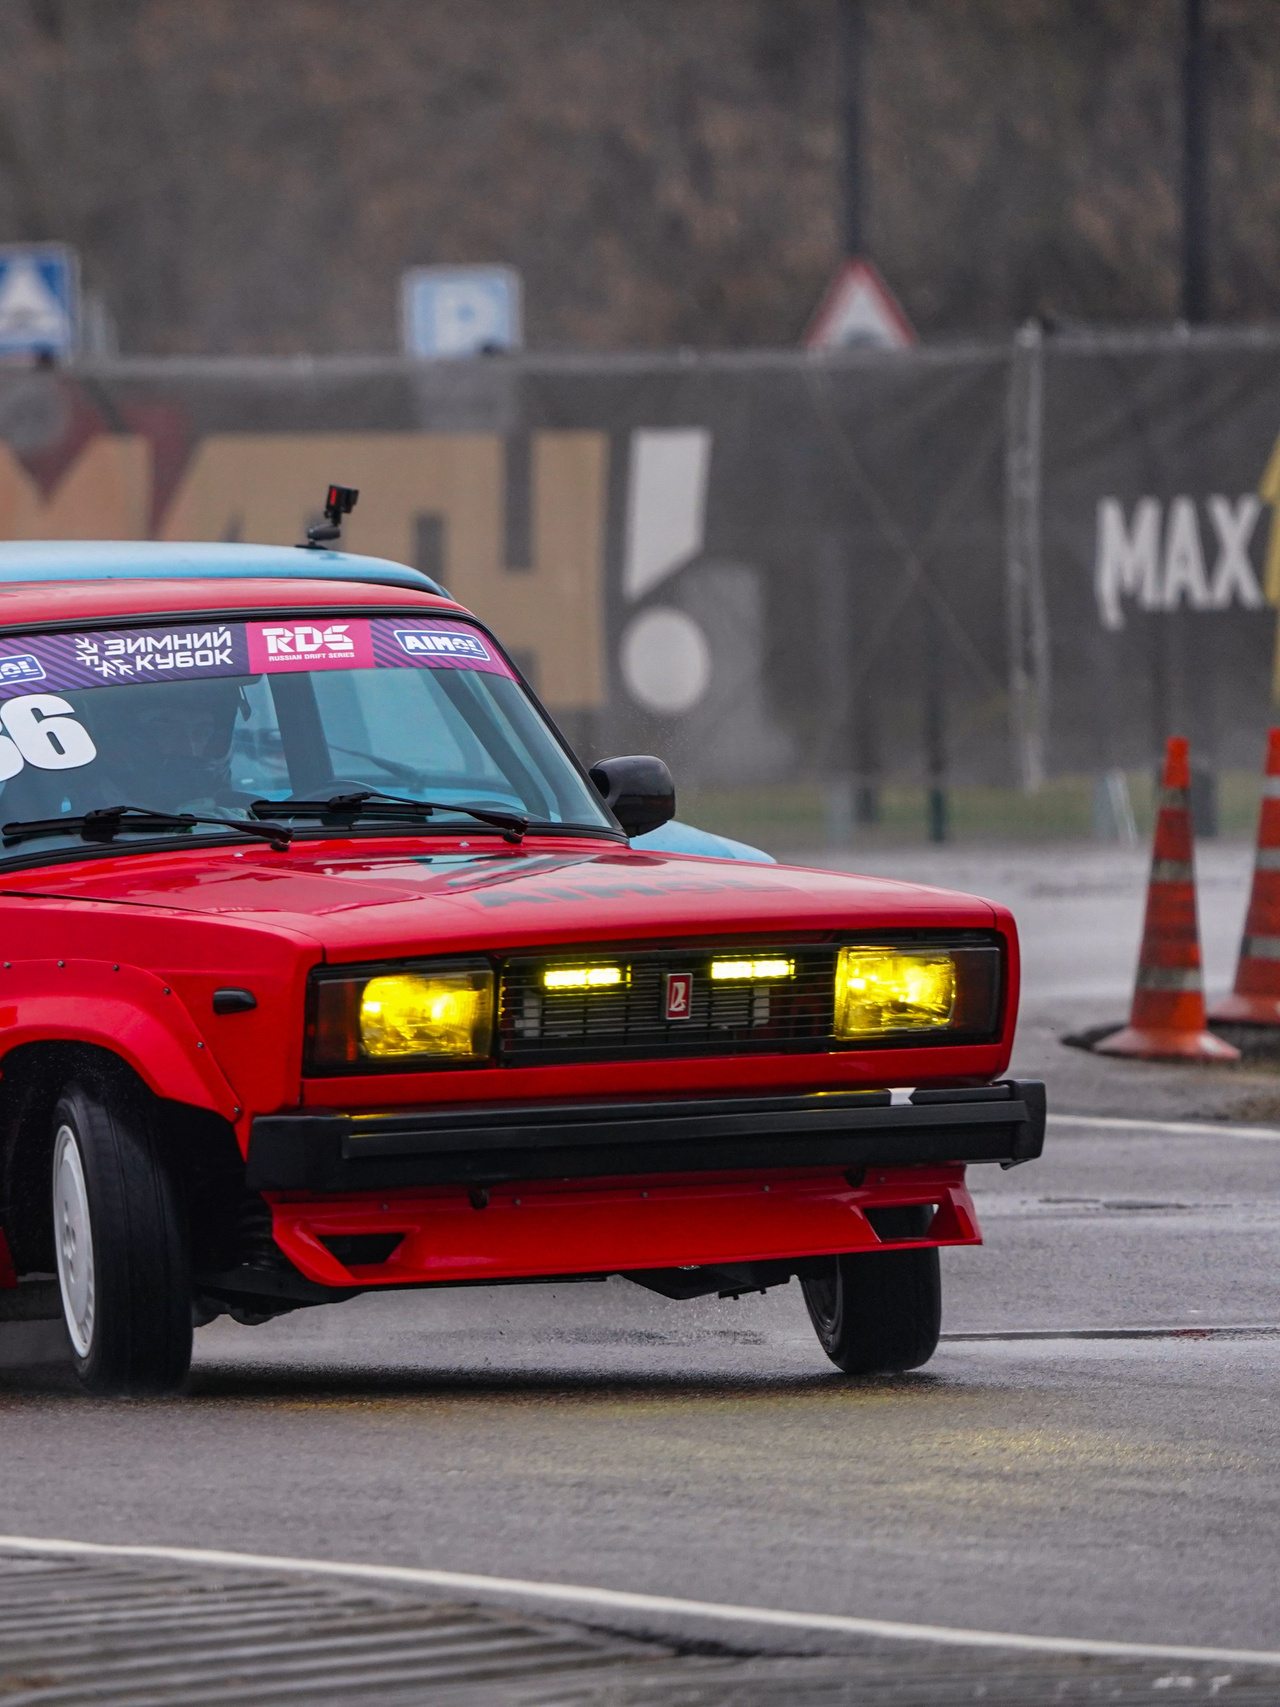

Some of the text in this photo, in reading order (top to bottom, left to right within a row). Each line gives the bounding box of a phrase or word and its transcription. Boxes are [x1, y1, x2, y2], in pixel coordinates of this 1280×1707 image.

[104, 626, 233, 656] ЗИМНИЙ
[261, 625, 354, 654] RDS
[404, 635, 486, 656] AIMOL
[135, 648, 233, 671] КУБОК
[268, 651, 355, 662] RUSSIAN DRIFT SERIES
